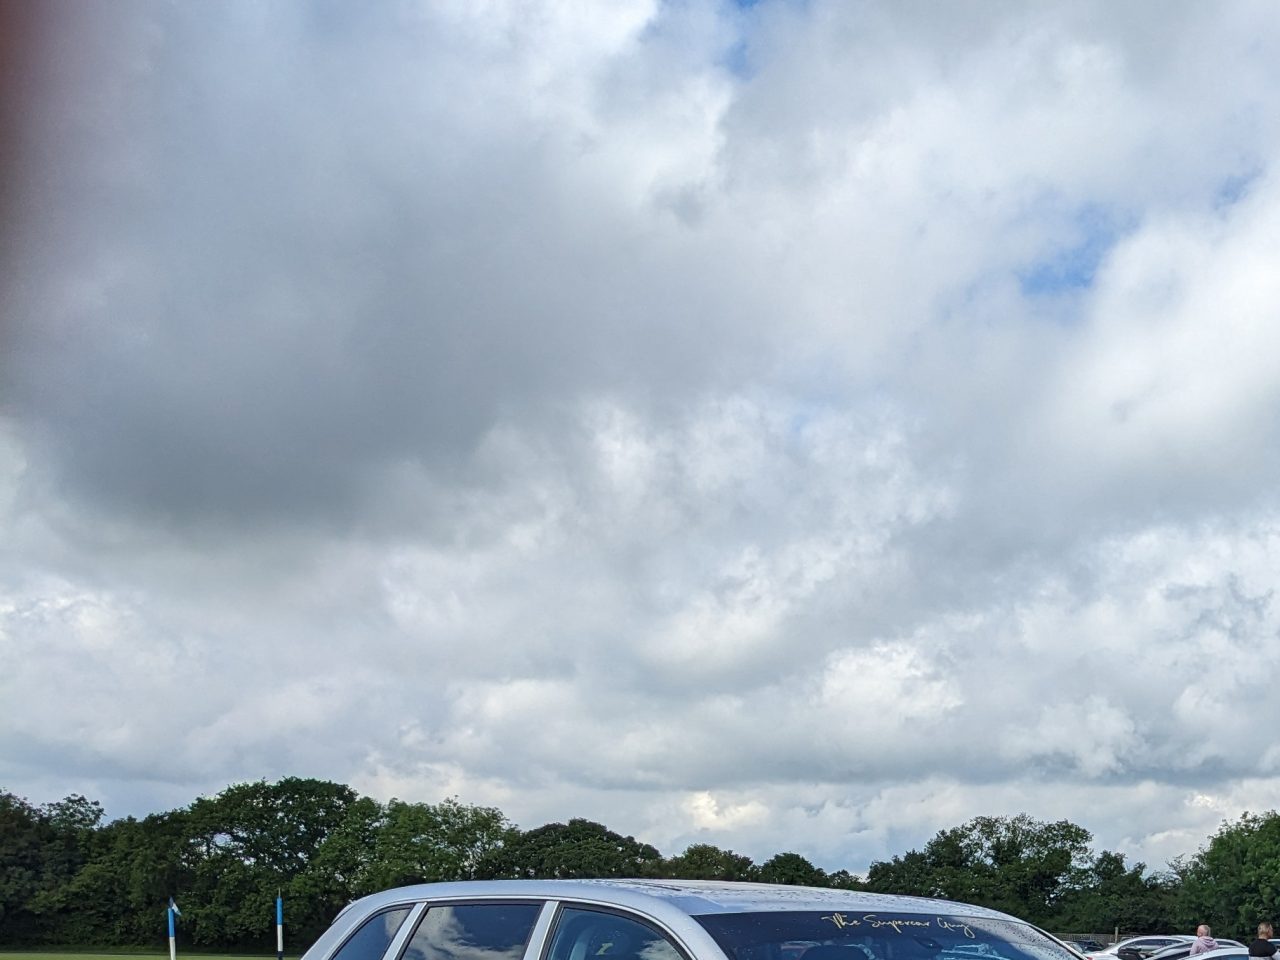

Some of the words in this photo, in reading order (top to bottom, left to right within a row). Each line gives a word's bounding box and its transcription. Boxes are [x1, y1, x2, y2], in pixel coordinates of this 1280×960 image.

[821, 912, 861, 929] The
[863, 914, 930, 934] Supercar
[937, 917, 975, 939] Guy
